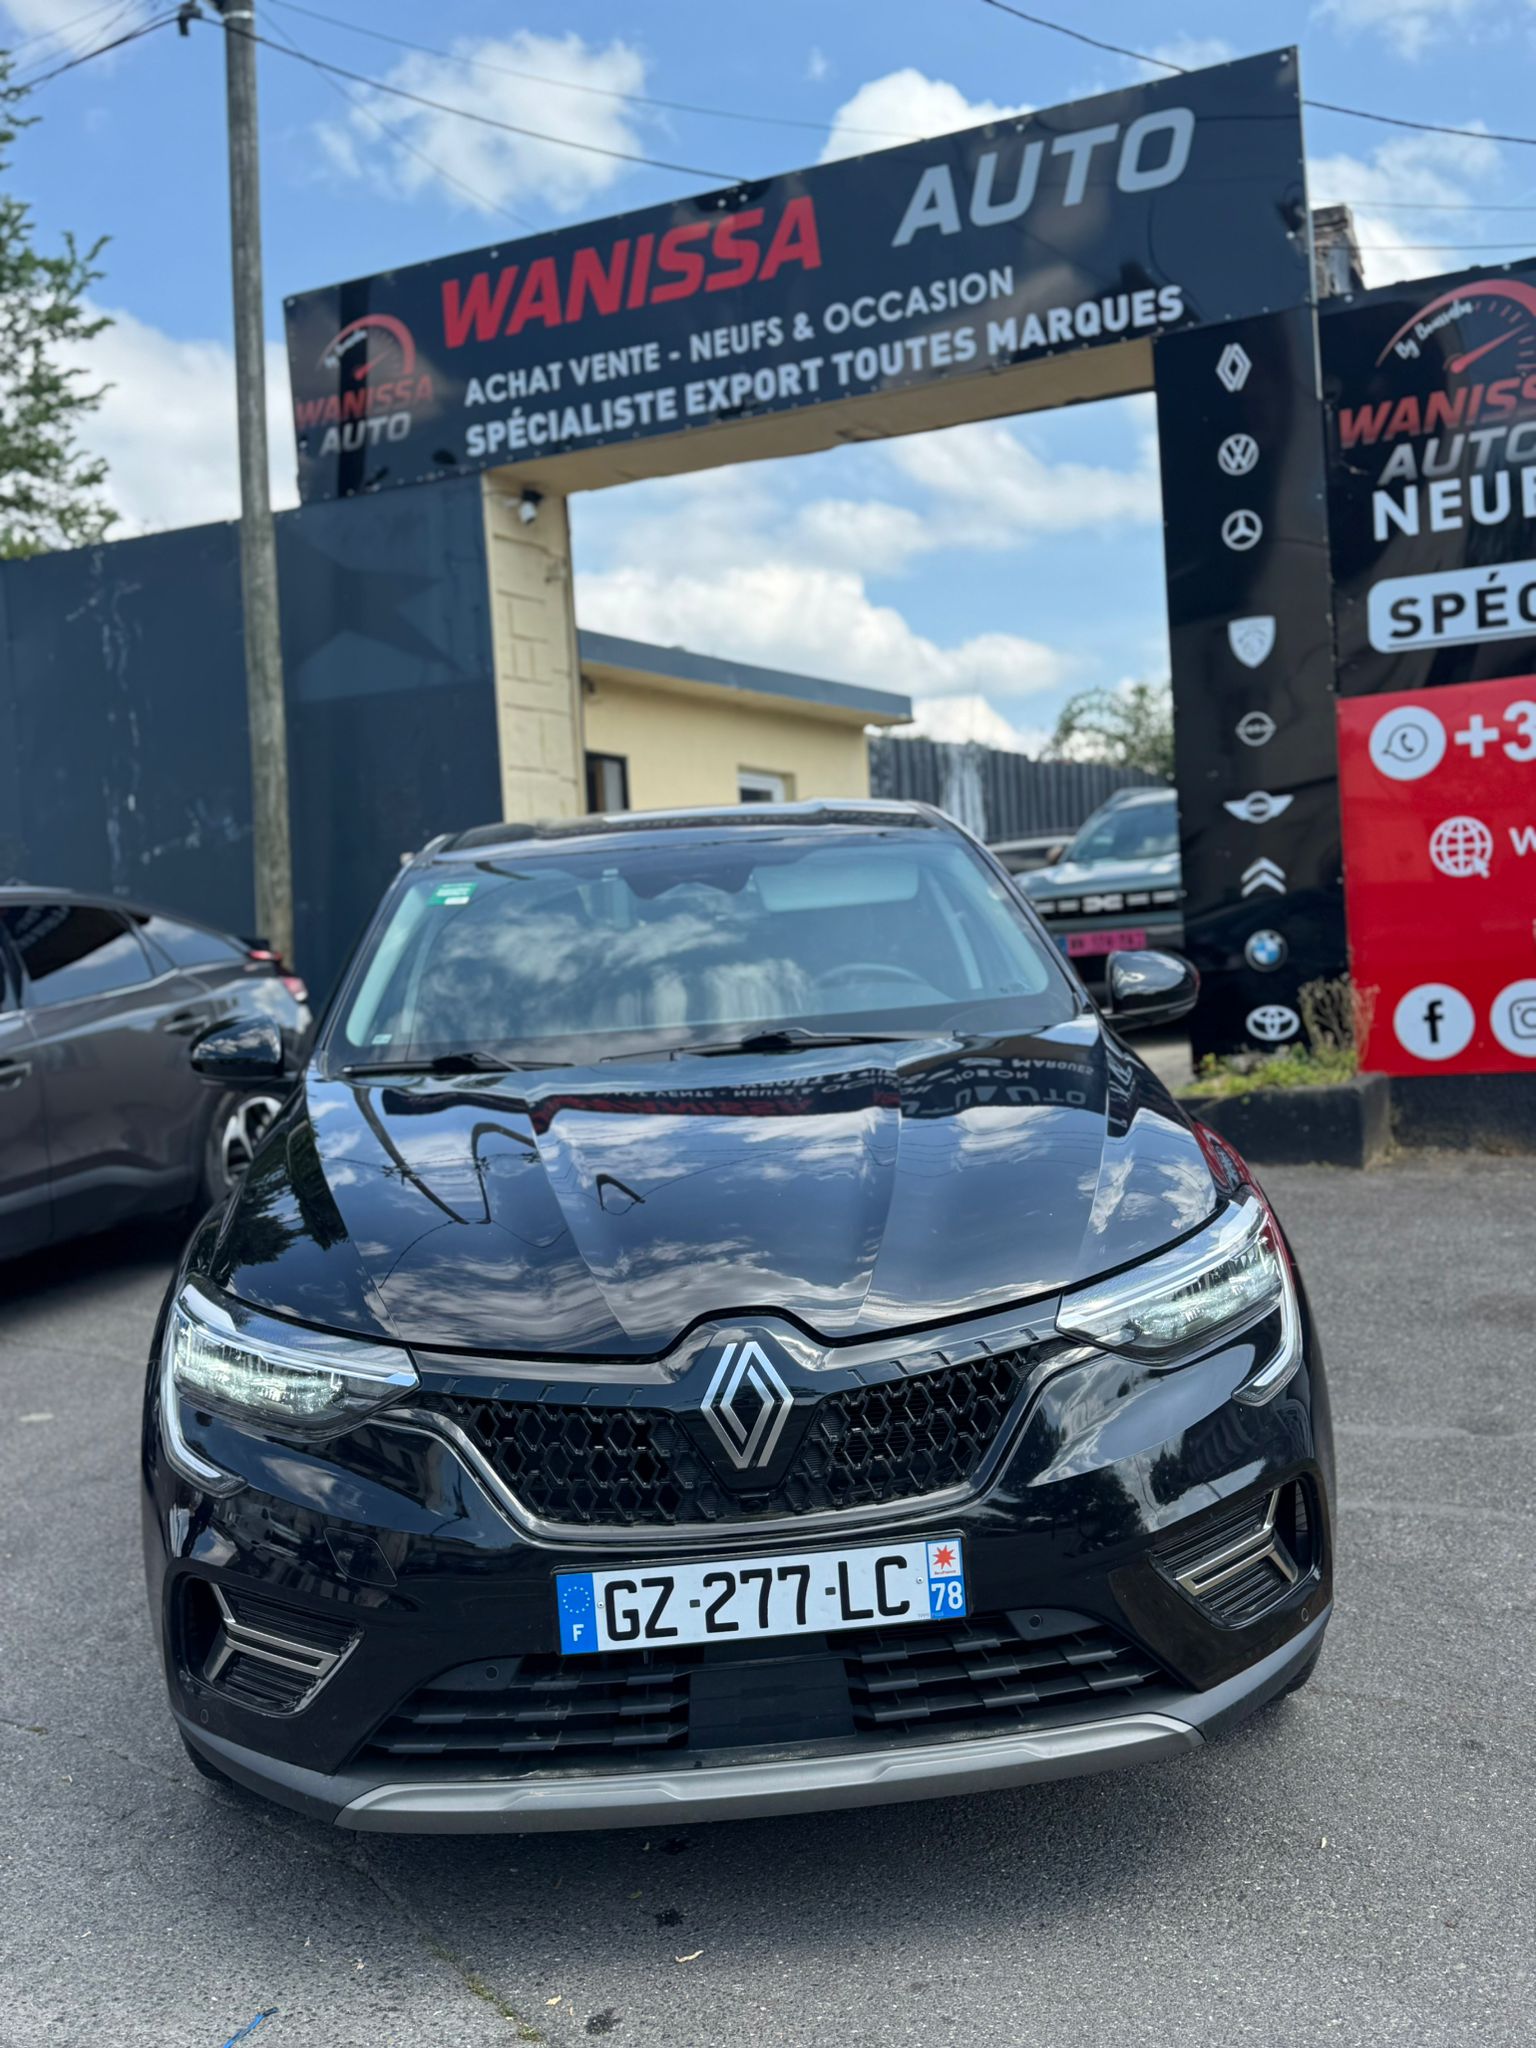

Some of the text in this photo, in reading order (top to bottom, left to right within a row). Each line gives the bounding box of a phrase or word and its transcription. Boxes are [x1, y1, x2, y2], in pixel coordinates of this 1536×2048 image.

[441, 107, 1195, 349] WANISSA AUTO
[464, 362, 562, 407] ACHAT
[569, 342, 661, 386] VENTE
[689, 316, 784, 363] NEUFS
[792, 312, 815, 342] &
[823, 265, 1015, 334] OCCASION
[465, 284, 1184, 457] SPÉCIALISTE EXPORT TOUTES MARQUES
[294, 373, 434, 430] WANISSA
[319, 411, 412, 458] AUTO
[572, 1555, 964, 1642] F GZ-277-LC 78
